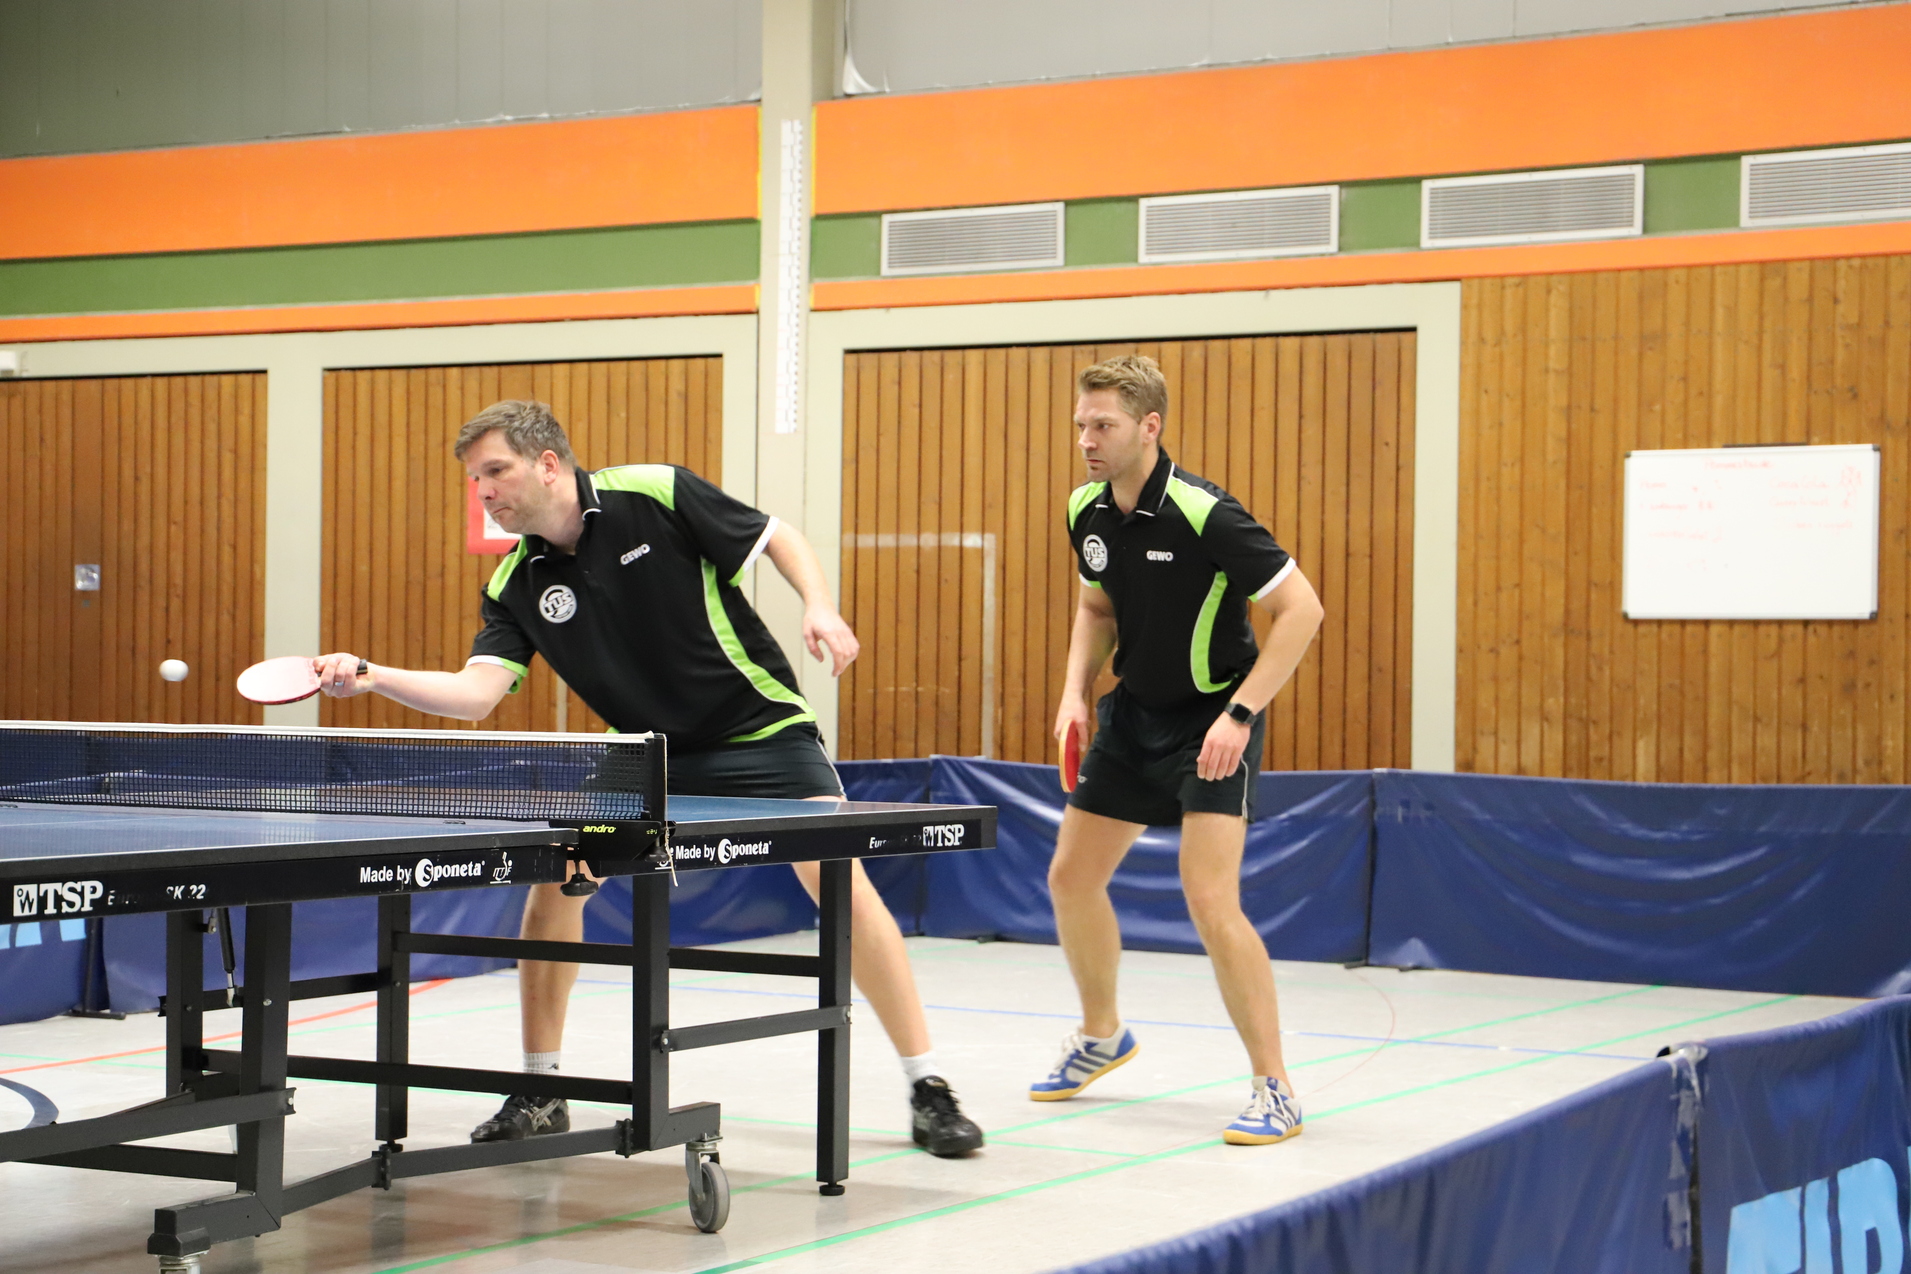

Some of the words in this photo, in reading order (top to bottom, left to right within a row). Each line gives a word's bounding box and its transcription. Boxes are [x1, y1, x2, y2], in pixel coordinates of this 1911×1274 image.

[620, 543, 651, 565] GEWO
[1146, 550, 1174, 562] GEWO
[582, 824, 616, 834] andro
[935, 823, 965, 847] TSP
[675, 844, 701, 860] Made
[703, 844, 716, 861] by
[717, 838, 769, 864] Sponeta
[360, 866, 394, 883] Made
[396, 864, 413, 885] by
[415, 858, 482, 888] Sponeta
[39, 880, 104, 914] TSP
